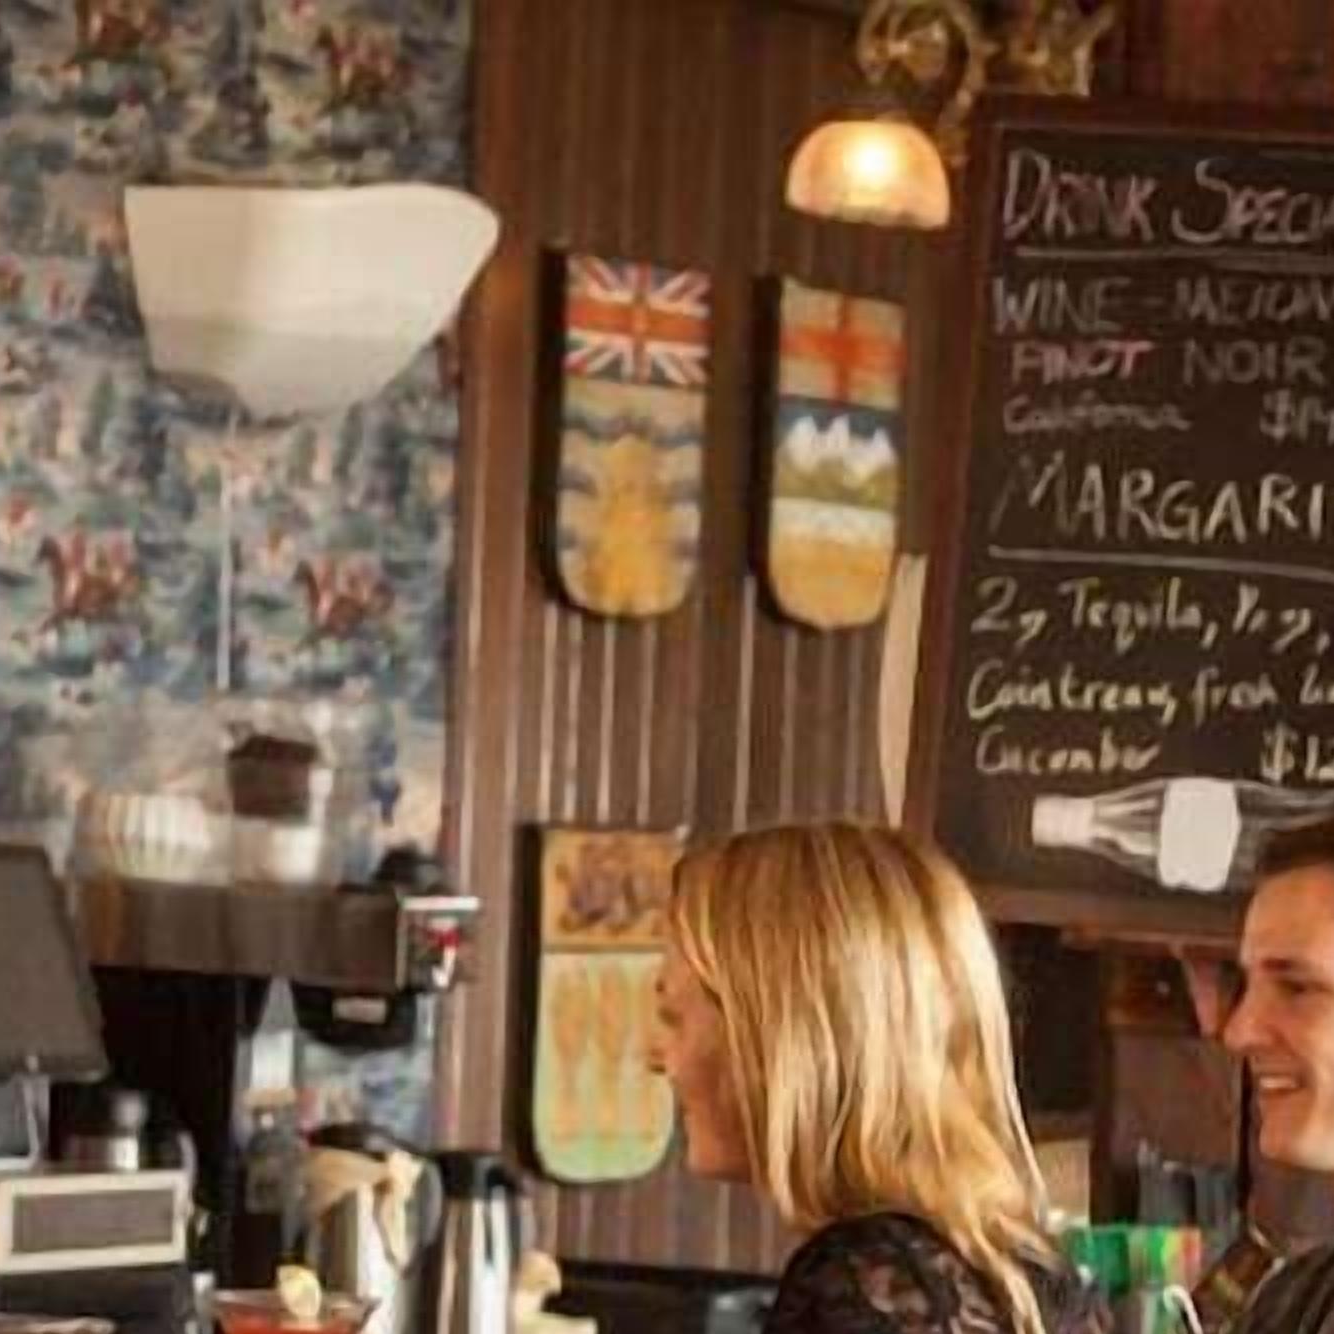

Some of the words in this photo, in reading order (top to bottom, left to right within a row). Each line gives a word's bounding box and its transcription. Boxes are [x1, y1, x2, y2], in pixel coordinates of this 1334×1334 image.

[1004, 148, 1158, 242] DRINK
[992, 276, 1131, 334] WINE
[1182, 337, 1326, 386] NOIR
